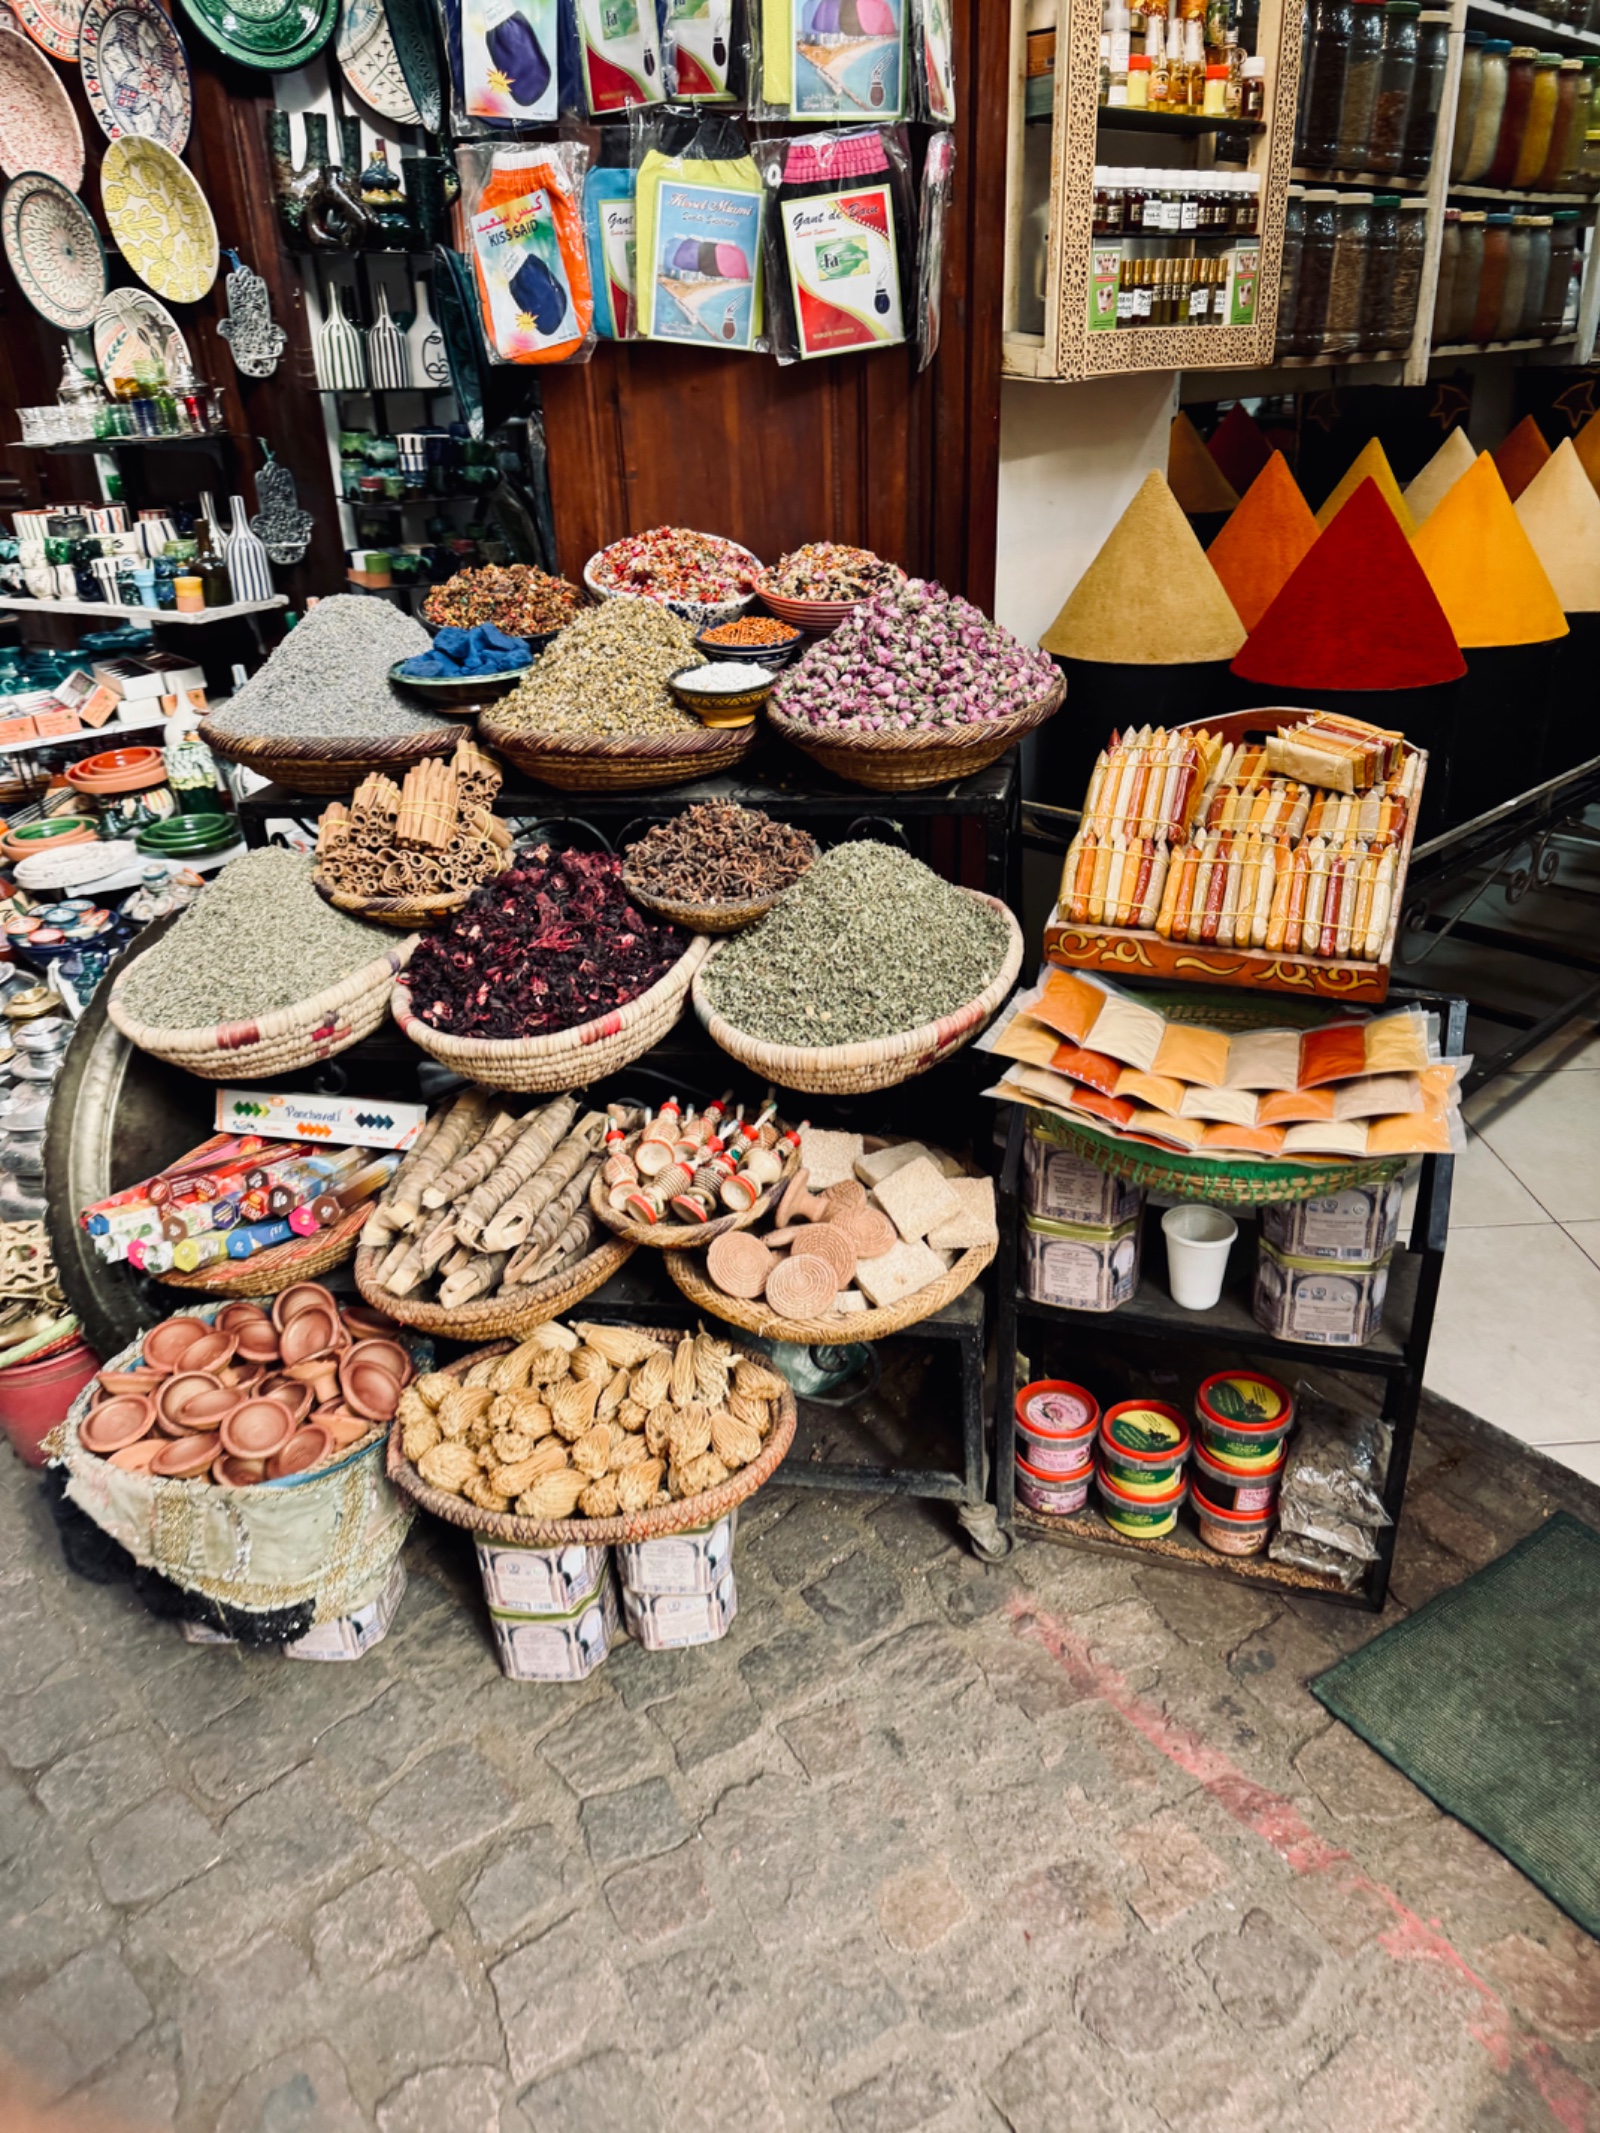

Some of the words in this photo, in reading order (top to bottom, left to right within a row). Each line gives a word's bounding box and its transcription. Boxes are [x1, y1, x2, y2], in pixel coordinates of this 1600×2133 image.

[607, 211, 634, 230] Gant
[792, 211, 824, 231] Gant
[828, 208, 842, 221] de
[488, 228, 512, 247] KISS
[513, 219, 538, 238] SAID
[823, 253, 839, 269] Fa
